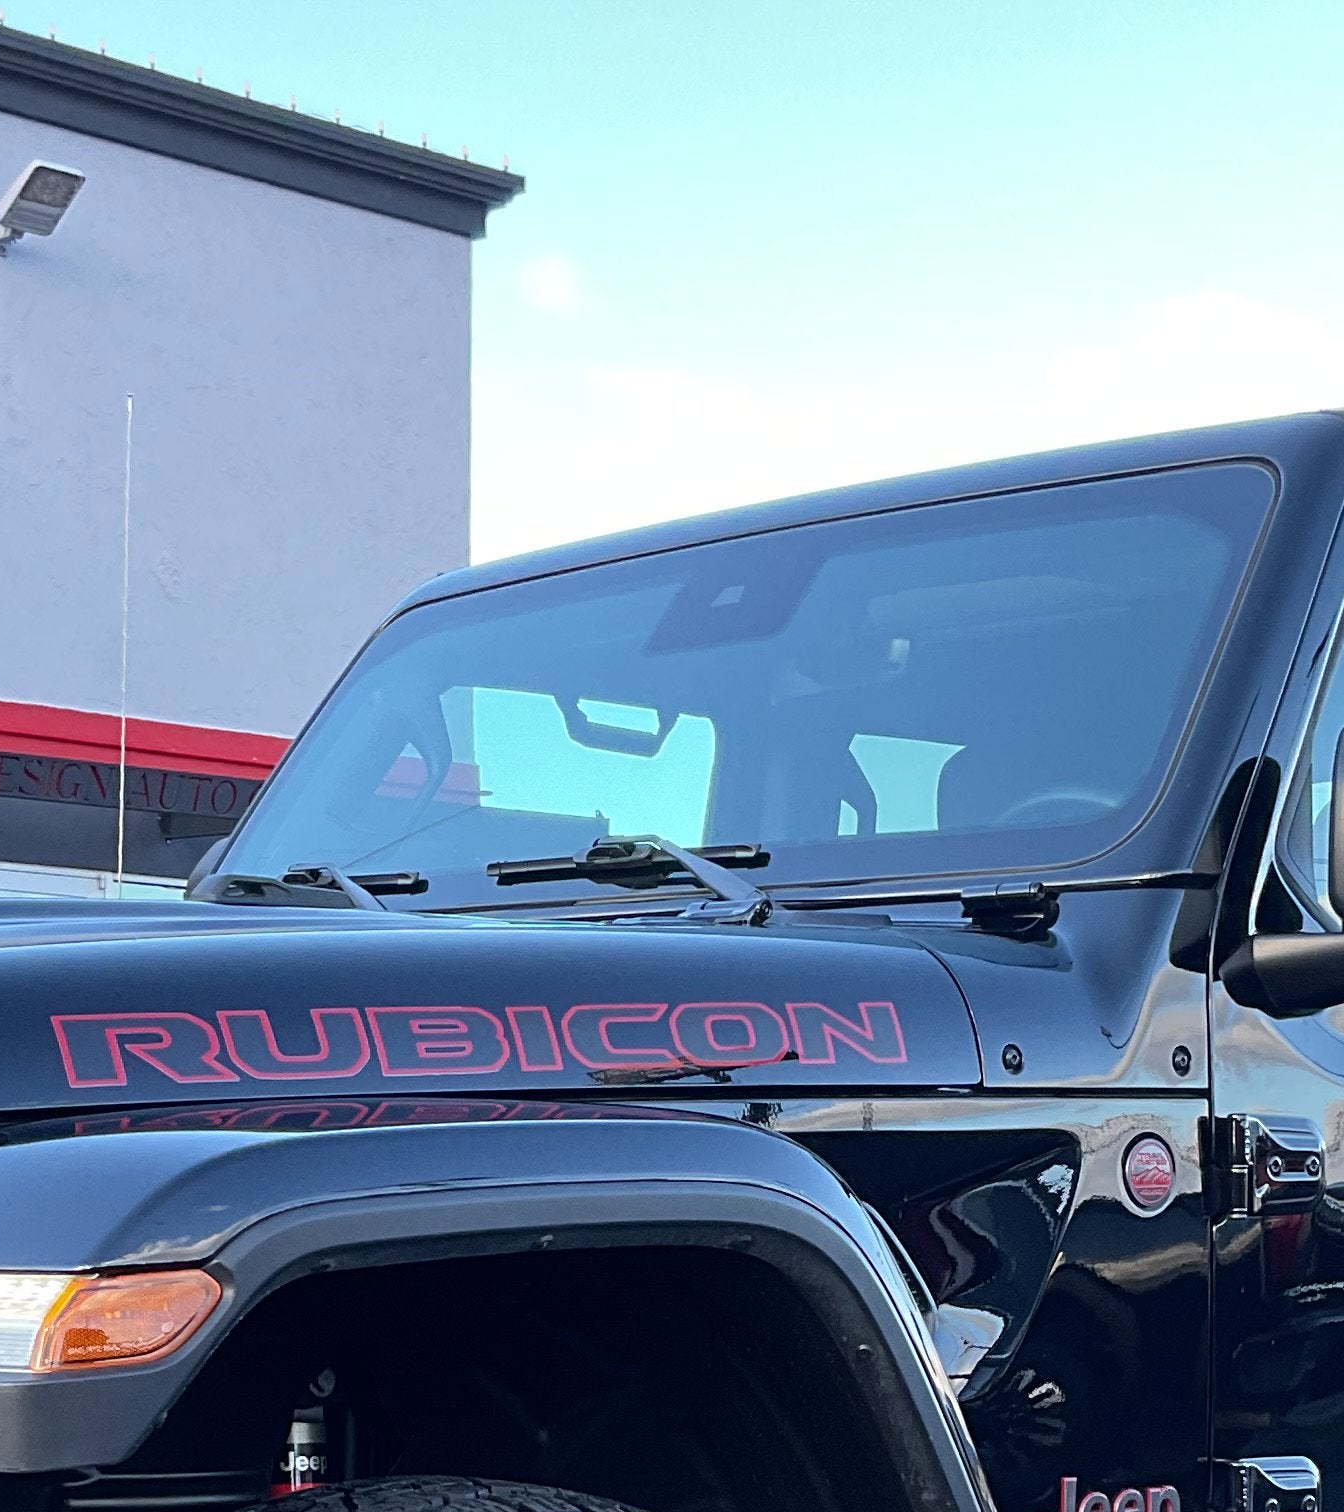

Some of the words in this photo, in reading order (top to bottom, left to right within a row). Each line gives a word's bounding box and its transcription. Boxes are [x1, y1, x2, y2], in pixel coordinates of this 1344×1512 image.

[125, 773, 238, 815] AUTO
[50, 1001, 909, 1086] RUBICON
[279, 1451, 328, 1475] Jeep
